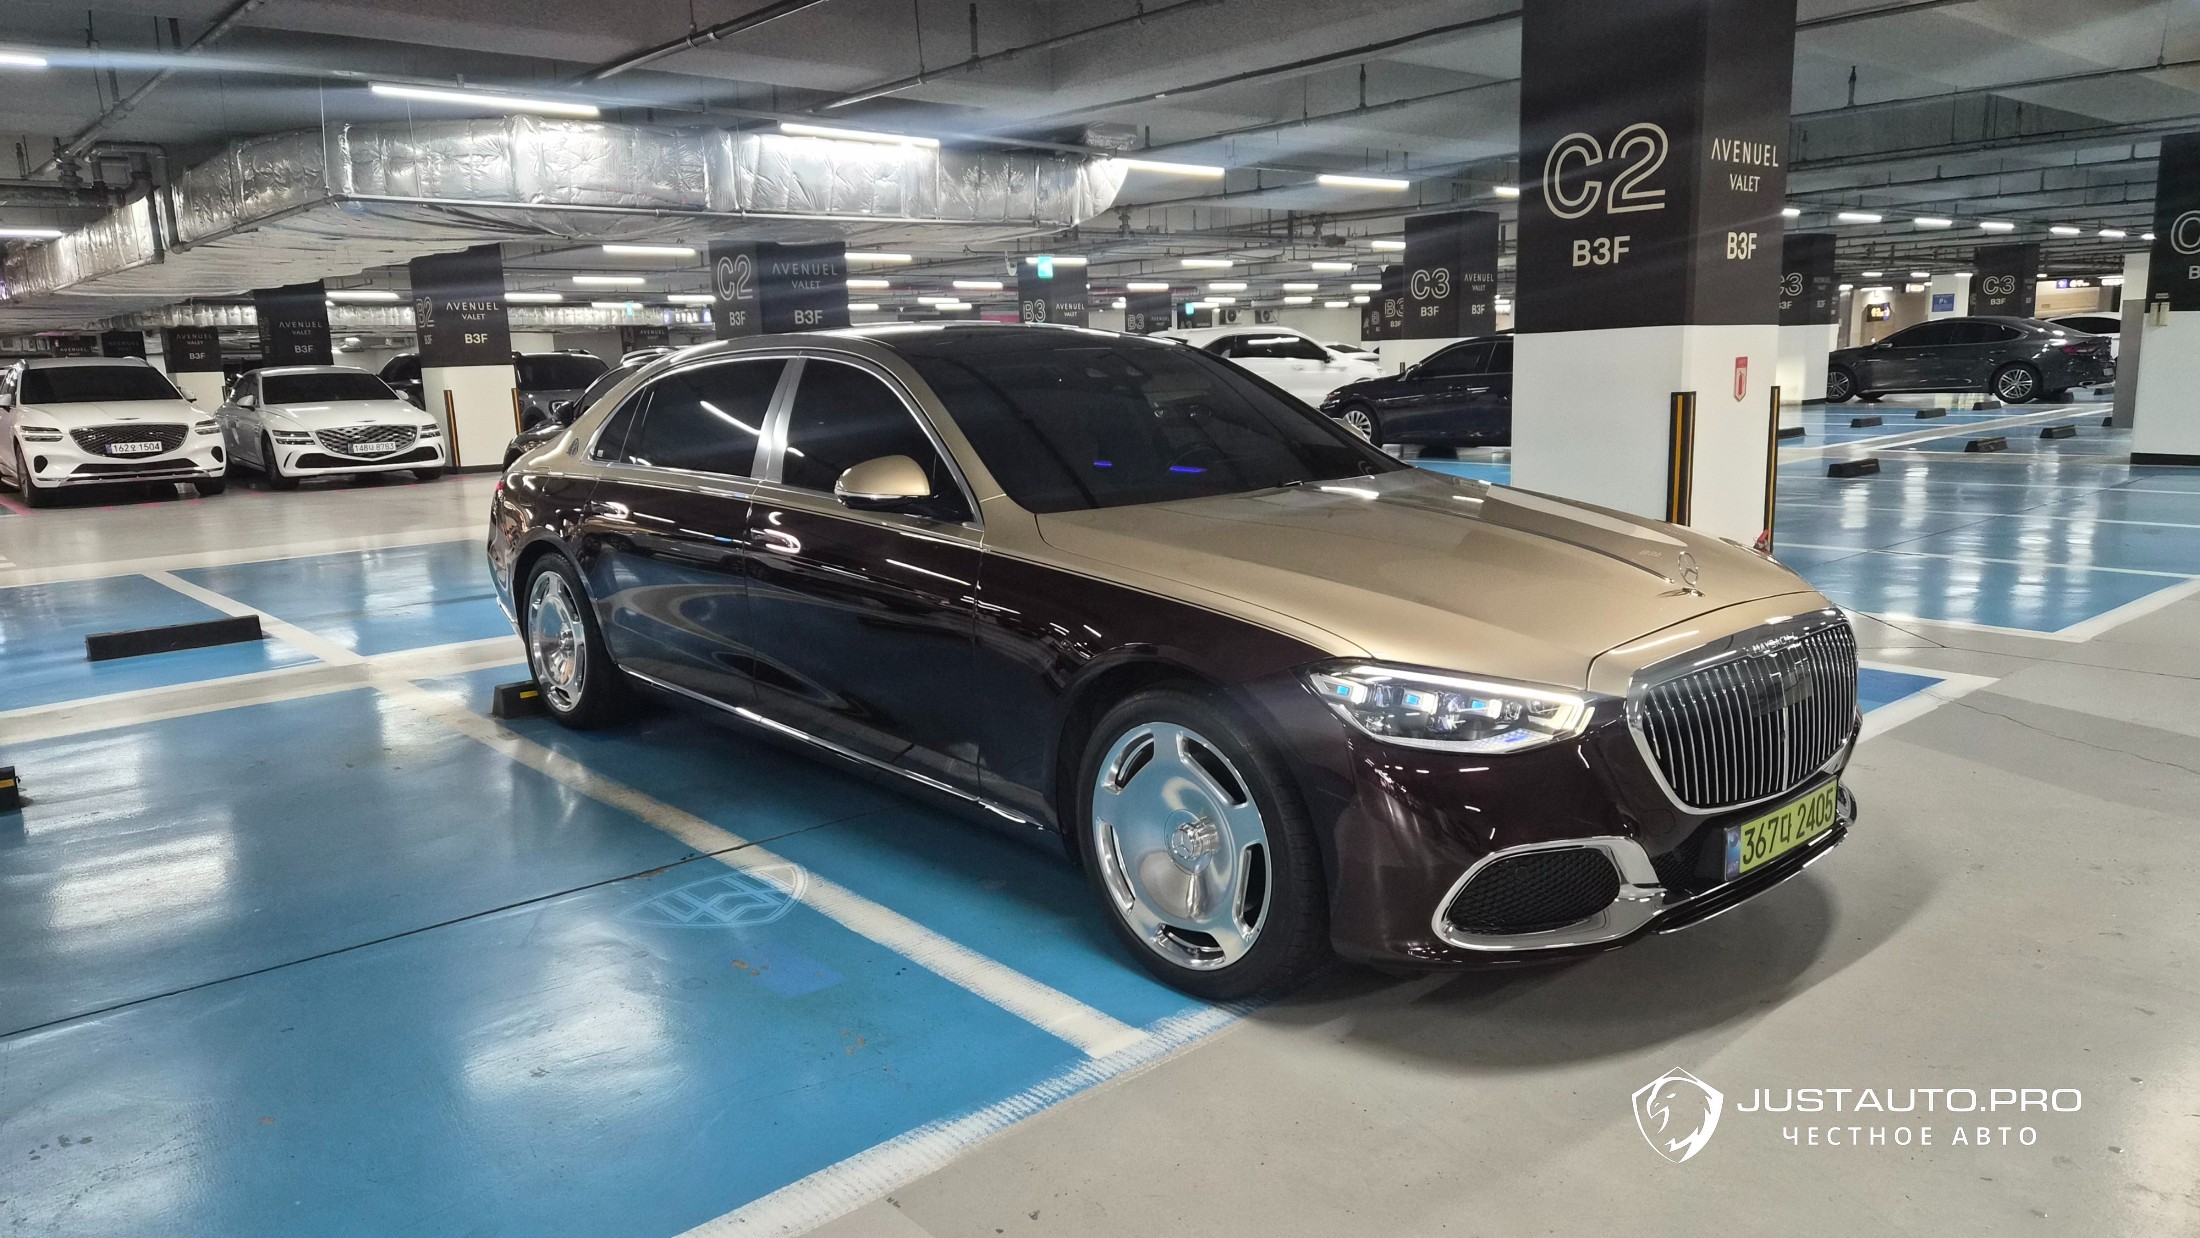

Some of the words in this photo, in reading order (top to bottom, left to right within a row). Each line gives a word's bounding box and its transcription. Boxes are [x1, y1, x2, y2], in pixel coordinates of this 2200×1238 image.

[1710, 137, 1780, 168] AVENUEL
[1542, 122, 1669, 220] C2
[1729, 173, 1761, 193] VALET
[1572, 235, 1631, 267] B3F
[1726, 231, 1758, 260] B3F
[771, 262, 839, 276] AVENUEL
[717, 254, 754, 301] C2
[791, 280, 821, 290] VALET
[1410, 267, 1450, 300] C3
[1463, 273, 1495, 282] AVENUEL
[1982, 275, 2016, 295] C3
[446, 301, 499, 311] AVENUEL
[1055, 302, 1086, 310] AVENUEL
[1990, 297, 2007, 305] B3F
[794, 309, 823, 325] B3F
[1023, 299, 1046, 323] B3
[1420, 305, 1440, 317] B3F
[1471, 304, 1486, 315] B3F
[729, 311, 746, 326] B3F
[1127, 313, 1145, 331] B3
[464, 333, 488, 344] B3F
[189, 352, 206, 360] B3F
[294, 344, 315, 354] B3F
[138, 442, 160, 451] 1504
[1742, 812, 1792, 865] 367다
[1795, 787, 1834, 840] 2405
